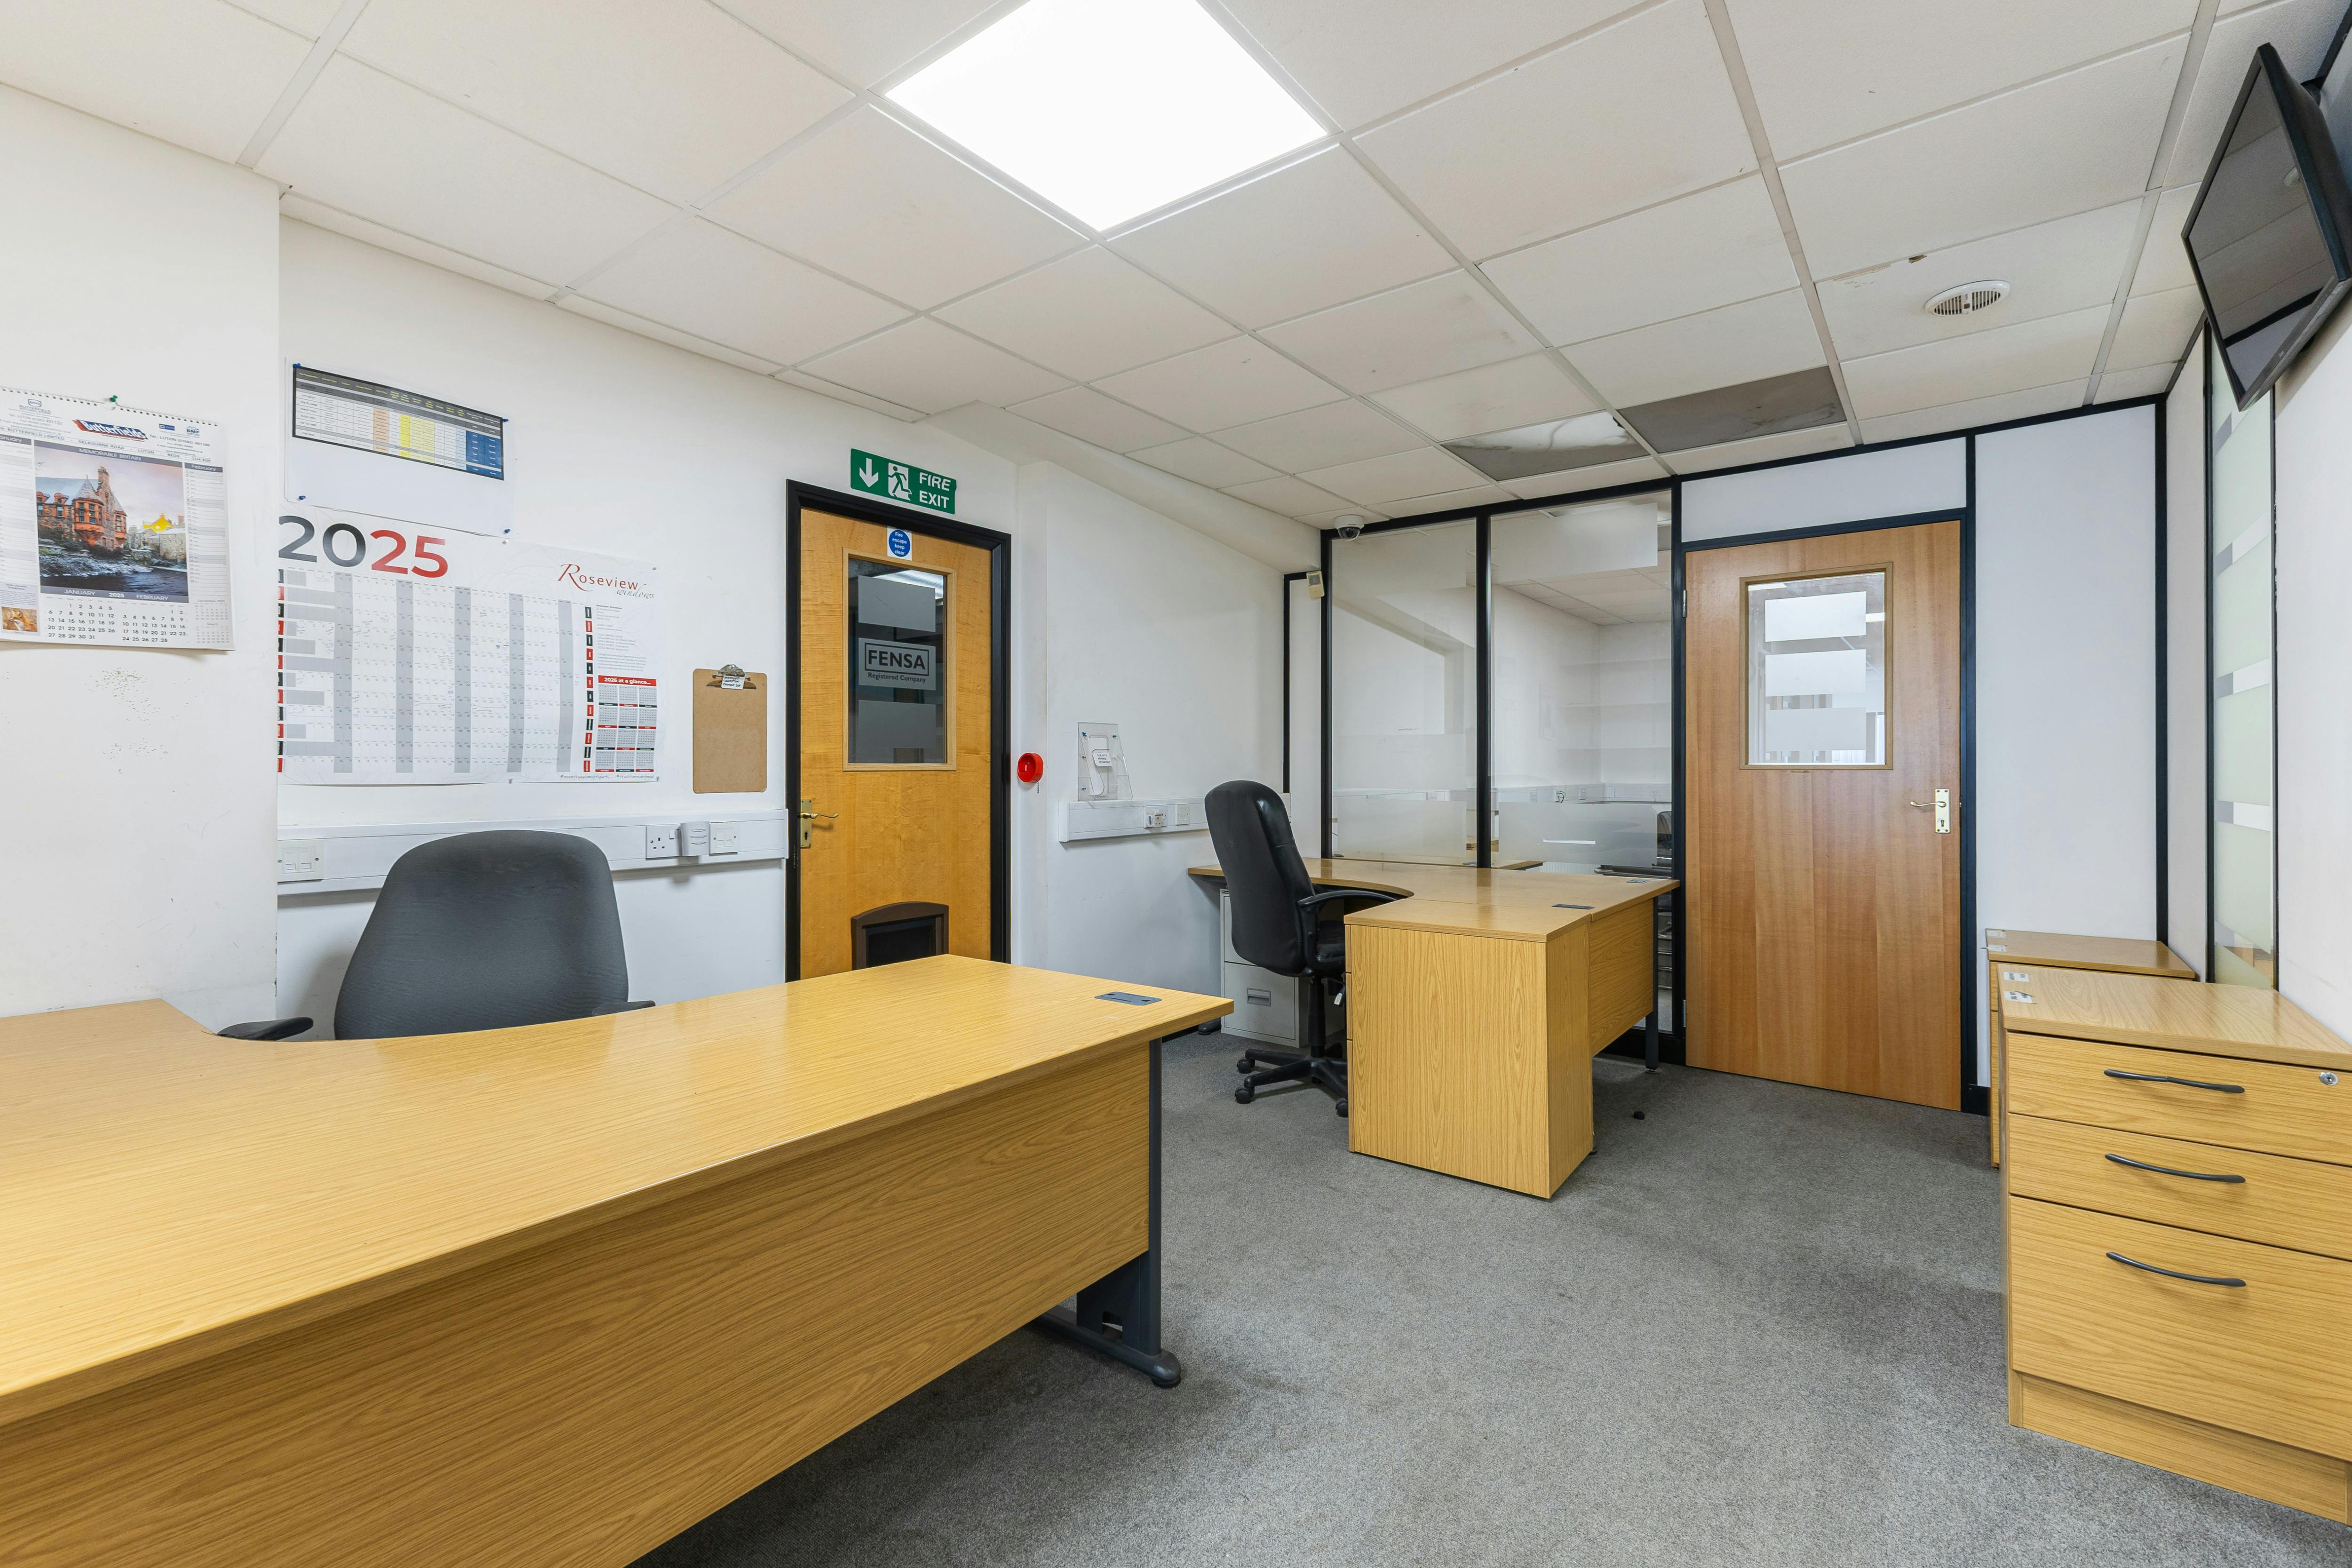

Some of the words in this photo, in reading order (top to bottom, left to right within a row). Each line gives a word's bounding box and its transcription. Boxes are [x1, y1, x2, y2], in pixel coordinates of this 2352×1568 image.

[8, 428, 42, 437] BUTTERFIELD
[81, 420, 145, 438] Butterfields
[79, 447, 118, 458] MEMORABLE
[920, 472, 951, 491] FIRE
[920, 490, 949, 508] EXIT
[278, 516, 448, 578] 2025
[557, 564, 638, 591] Roseview
[617, 583, 655, 599] windows
[868, 650, 925, 670] FENSA
[868, 672, 898, 680] Registered
[900, 675, 926, 684] Company
